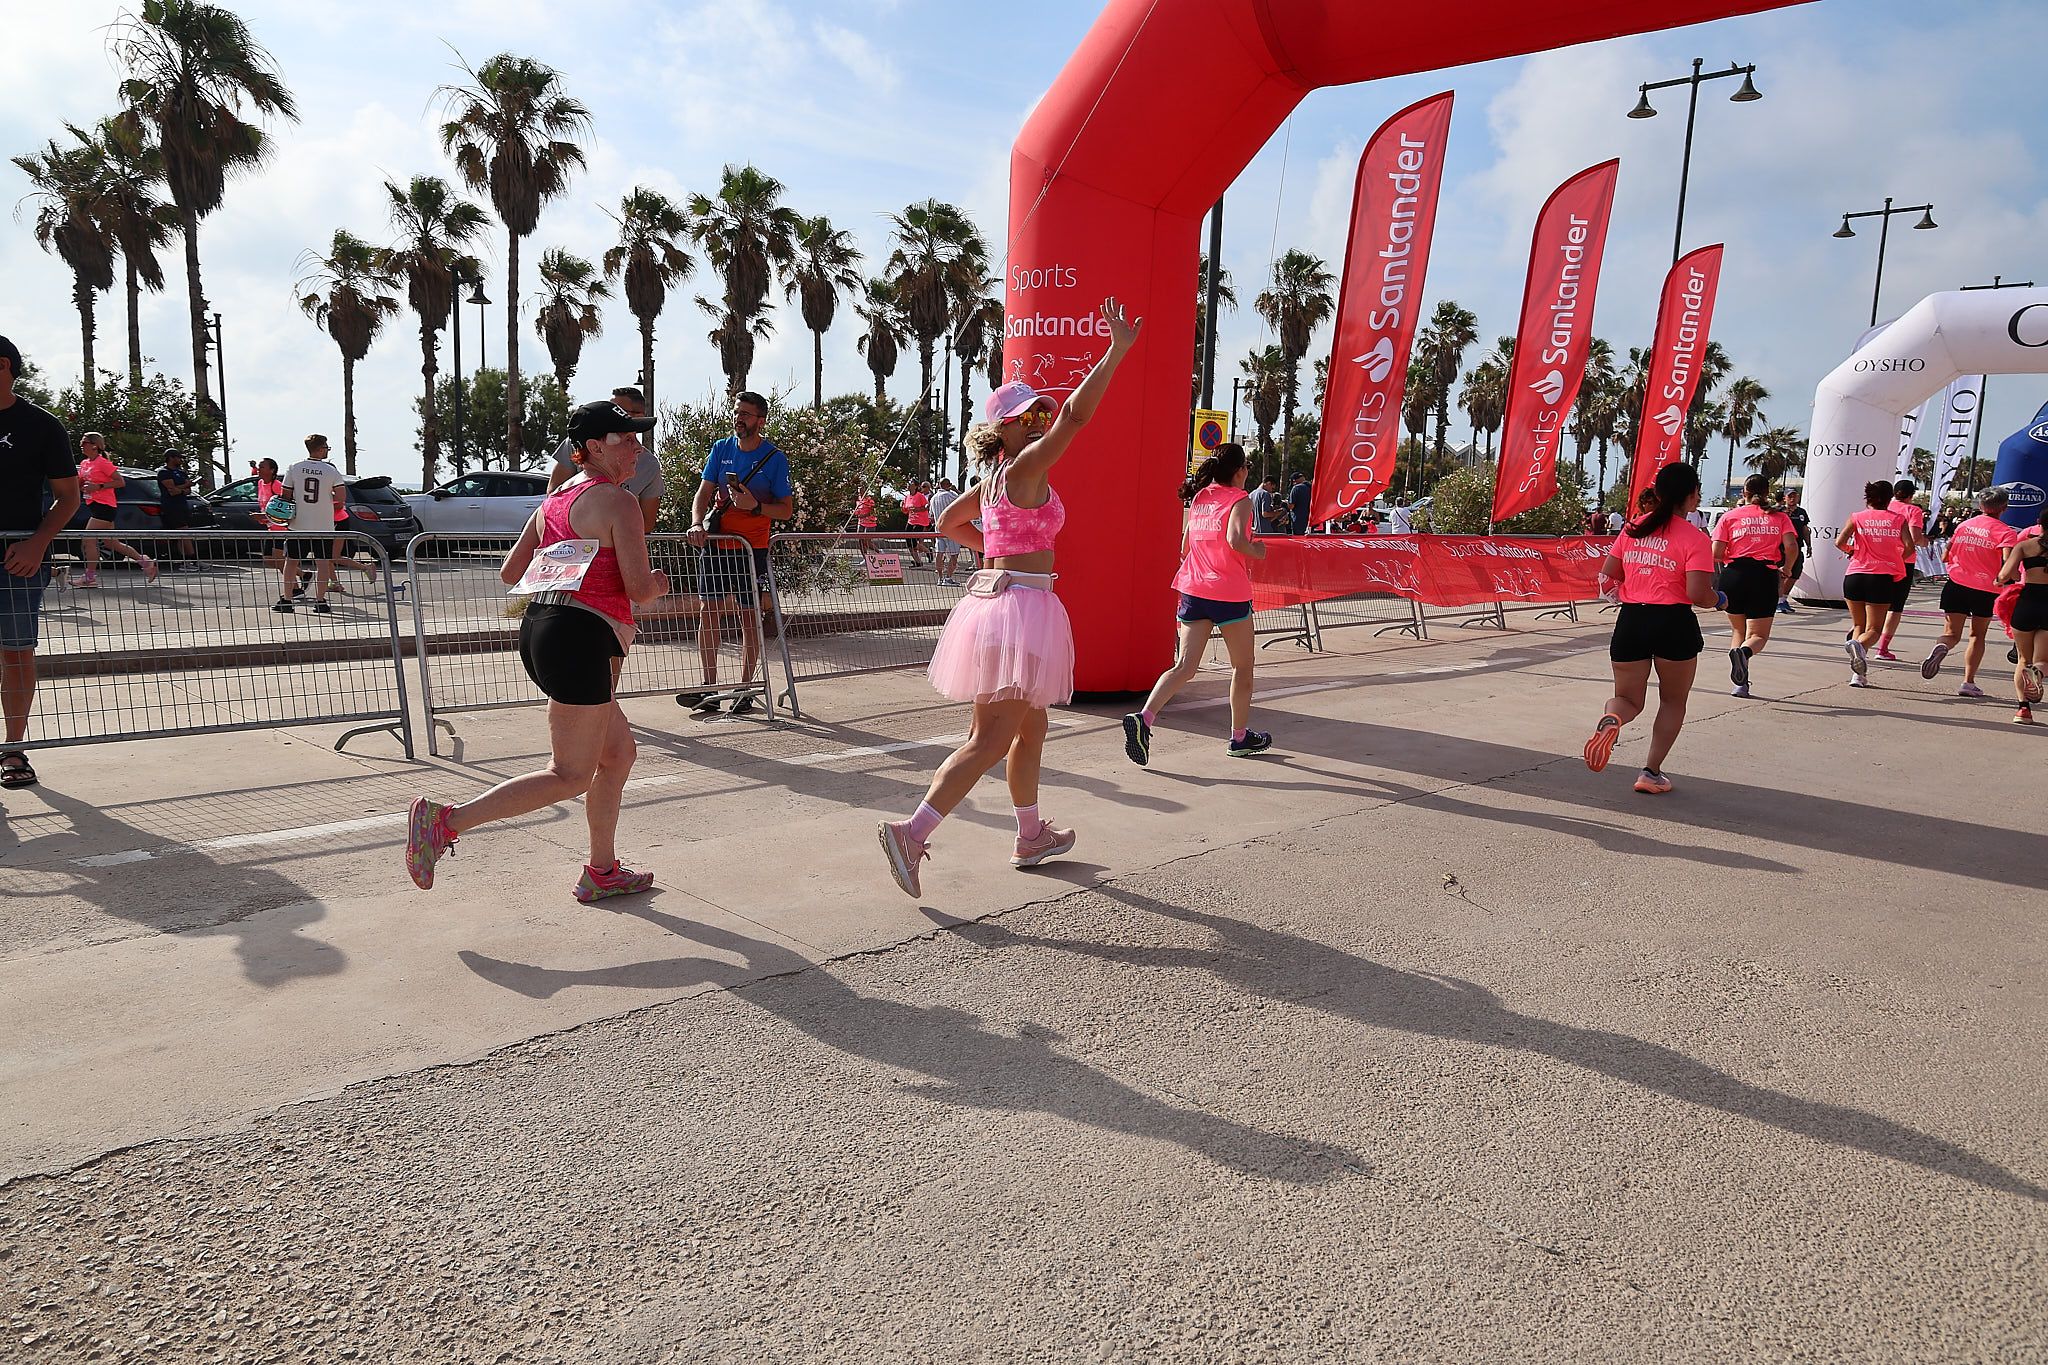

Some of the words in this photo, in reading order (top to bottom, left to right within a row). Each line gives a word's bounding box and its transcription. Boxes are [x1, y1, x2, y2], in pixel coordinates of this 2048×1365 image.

[1011, 263, 1077, 297] Sports
[1007, 311, 1111, 339] Santande
[1337, 391, 1386, 510] Sports
[1369, 132, 1425, 331] Santander
[1663, 266, 1705, 401] Santander
[1519, 410, 1558, 493] Sports
[1542, 213, 1589, 365] Santander
[1854, 358, 1926, 373] OYSHO
[1813, 443, 1877, 457] OYSHO
[303, 477, 320, 504] 9
[2008, 493, 2042, 502] URIANA
[1741, 516, 1769, 526] SOMOS
[1864, 519, 1892, 527] SOMOS
[1963, 526, 1991, 538] SOMOS
[1442, 540, 1487, 560] Sports
